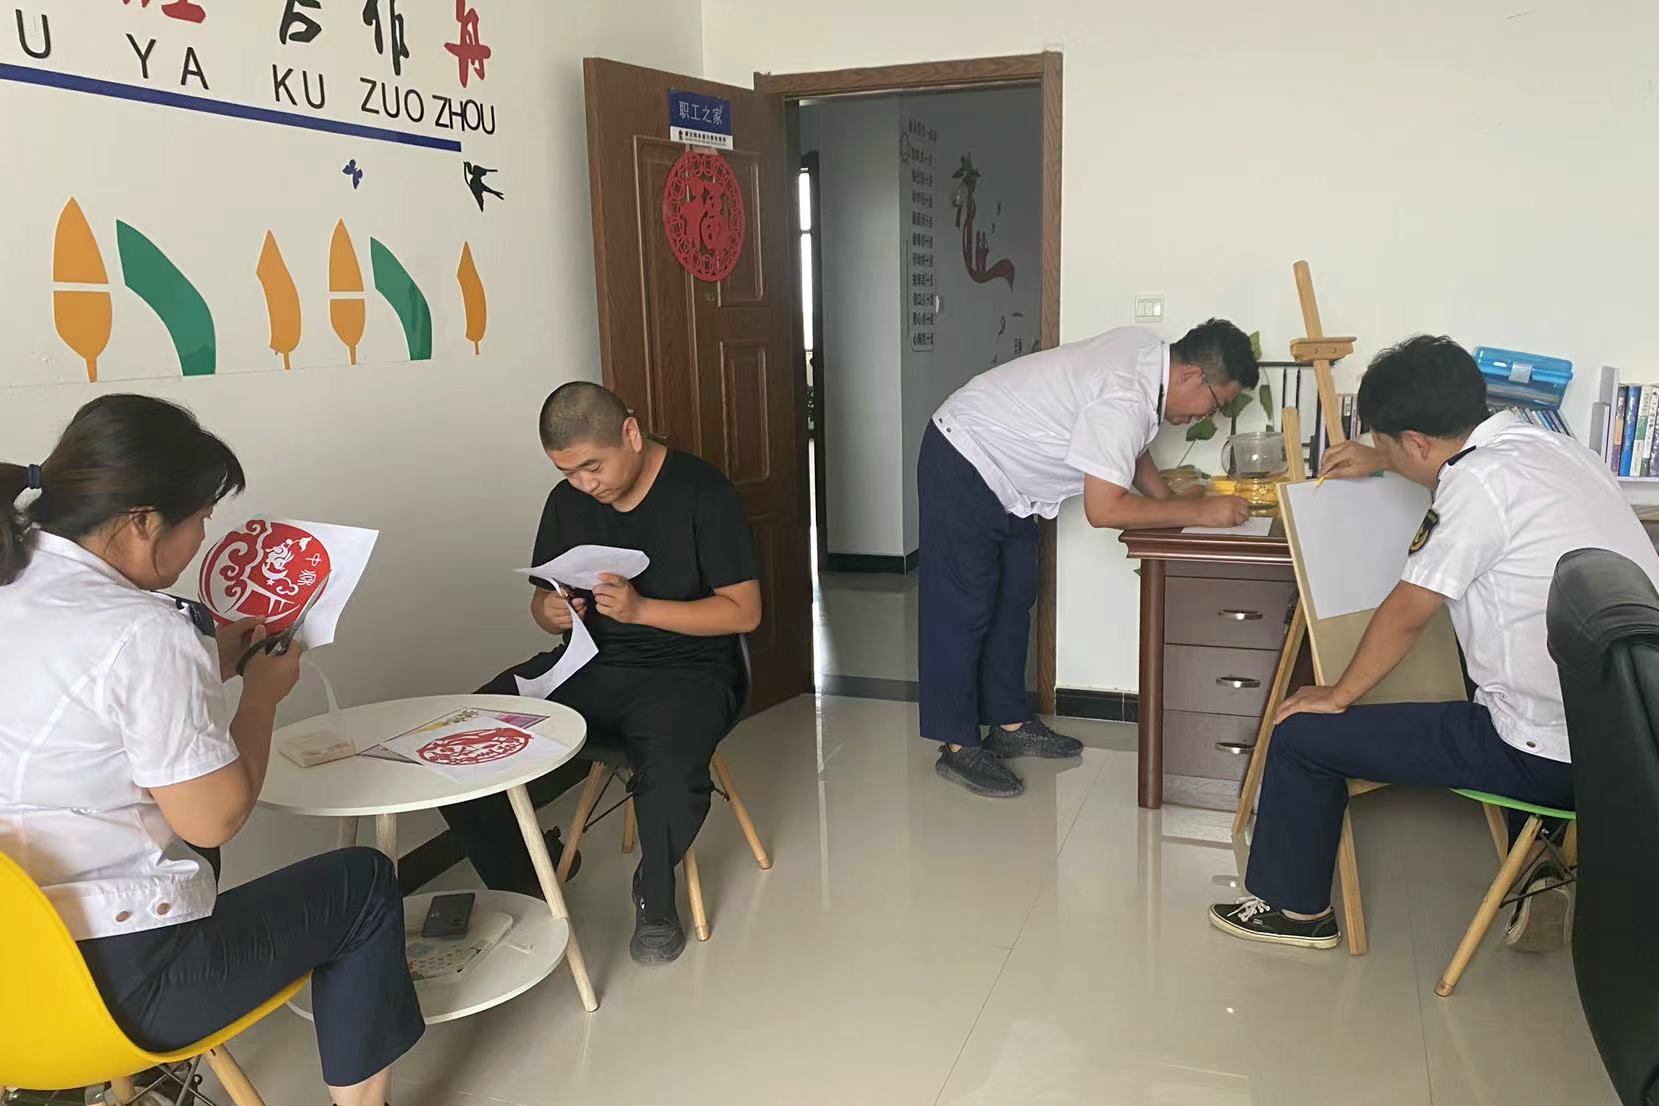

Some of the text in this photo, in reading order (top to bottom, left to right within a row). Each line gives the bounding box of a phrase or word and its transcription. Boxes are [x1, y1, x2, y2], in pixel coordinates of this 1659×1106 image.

[272, 64, 326, 110] KU
[360, 77, 425, 123] ZUO
[431, 94, 496, 135] ZHOU
[679, 101, 723, 125] 职工之家
